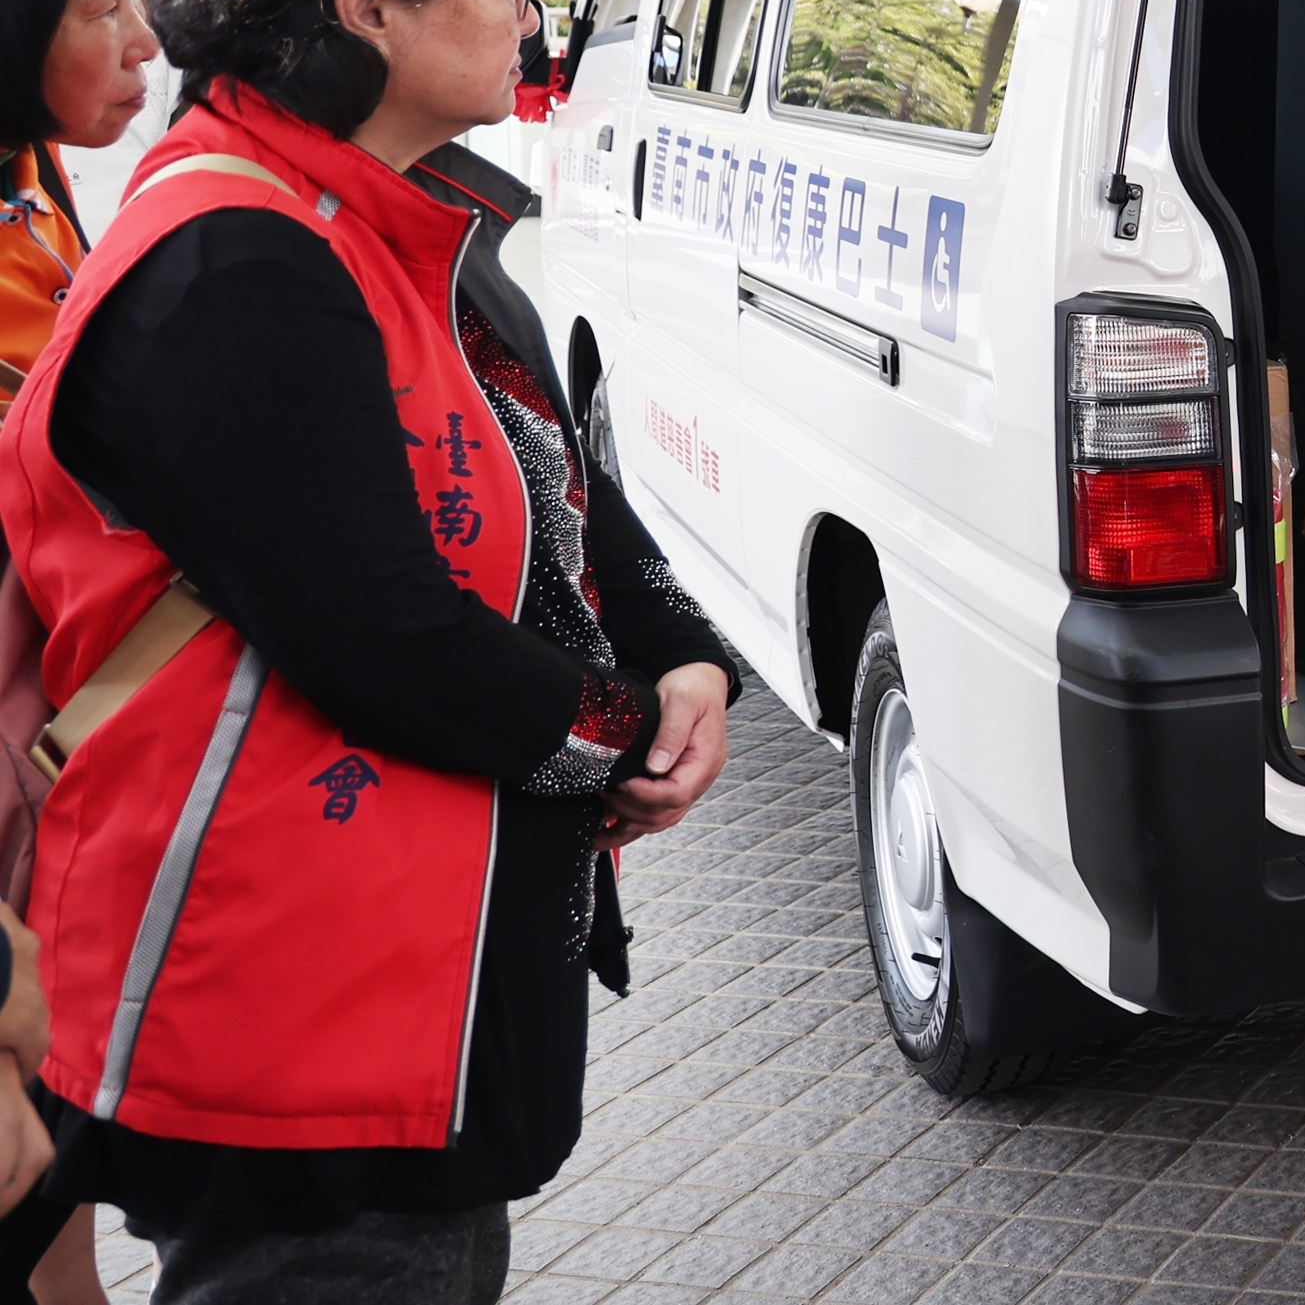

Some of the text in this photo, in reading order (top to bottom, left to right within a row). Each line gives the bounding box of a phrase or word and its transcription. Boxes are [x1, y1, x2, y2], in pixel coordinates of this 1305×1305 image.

[650, 125, 908, 312] 臺南市政府復康巴士
